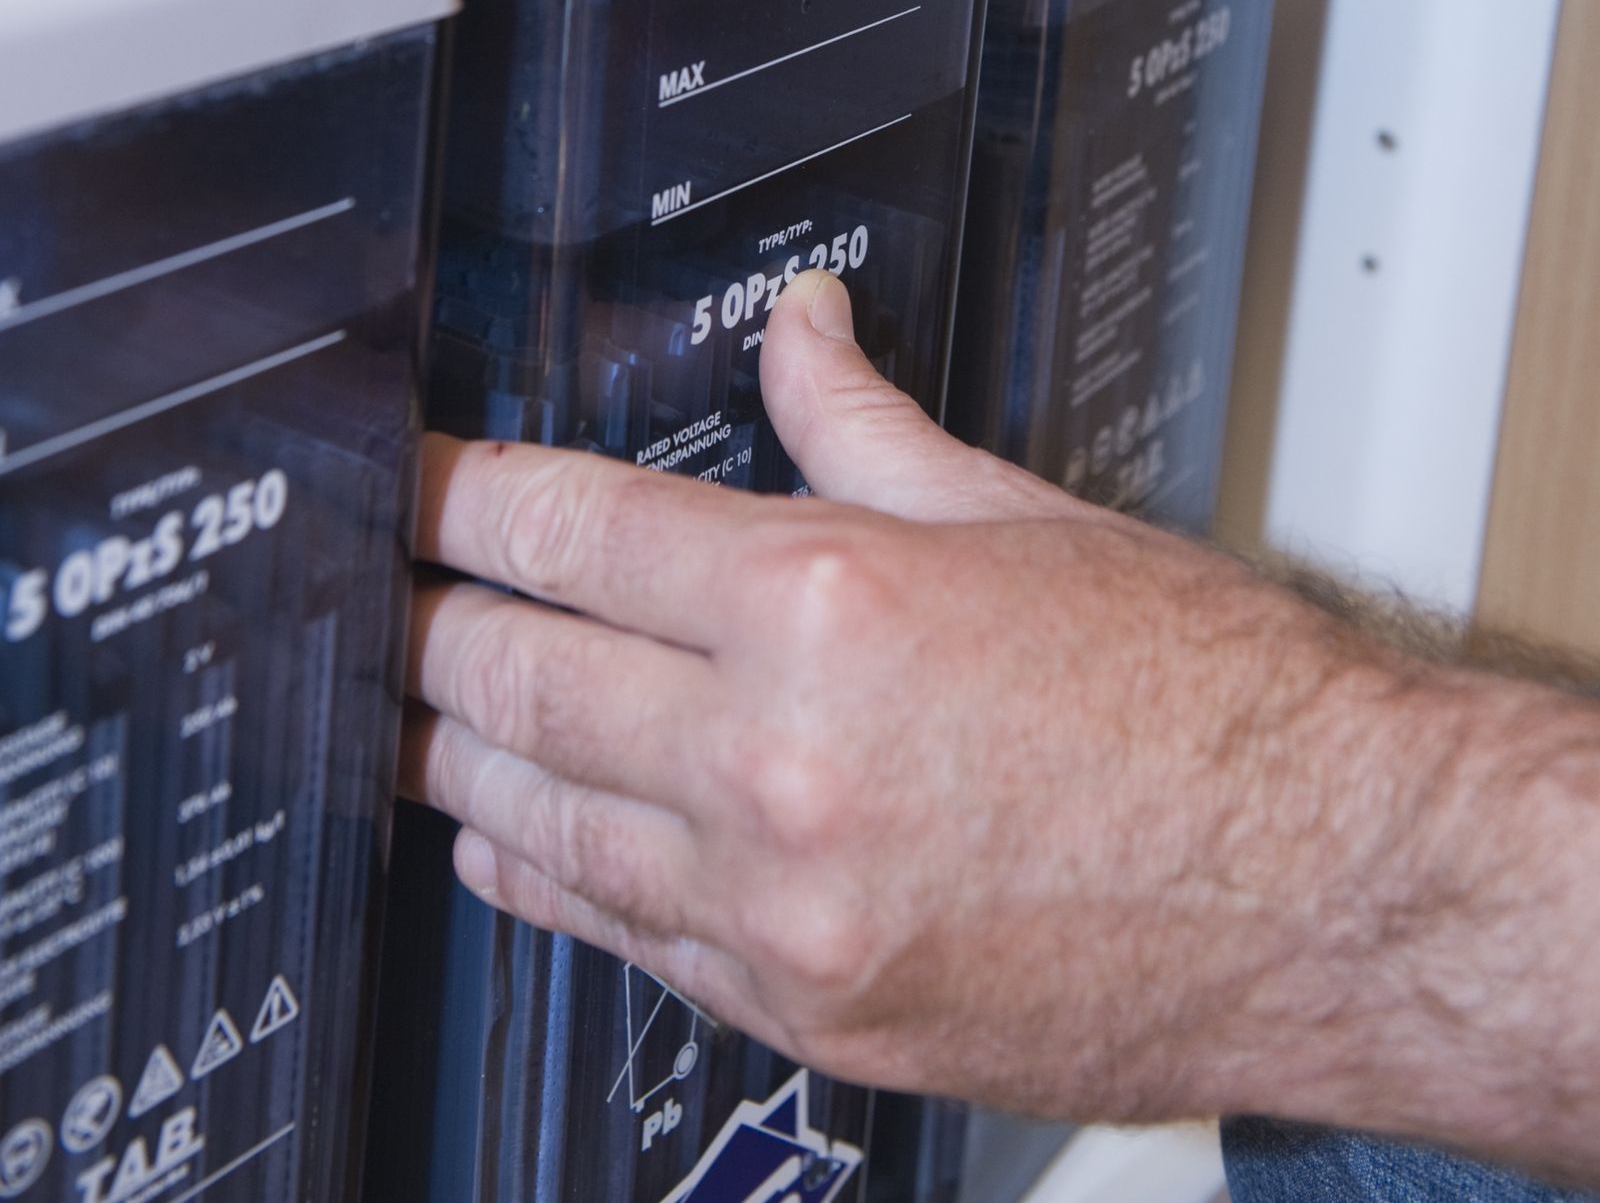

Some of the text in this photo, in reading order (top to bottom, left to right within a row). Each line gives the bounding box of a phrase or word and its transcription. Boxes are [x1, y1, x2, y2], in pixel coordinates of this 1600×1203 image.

[659, 60, 706, 101] MAX
[1127, 55, 1144, 98] 5
[652, 180, 692, 220] MIN
[758, 219, 813, 254] TYPE/TYP:
[690, 294, 713, 345] 5
[636, 411, 722, 466] RATED VOLTAGE
[4, 567, 49, 642] 5
[54, 509, 185, 618] OPzS
[189, 468, 288, 561] 250
[641, 1097, 683, 1152] Pb
